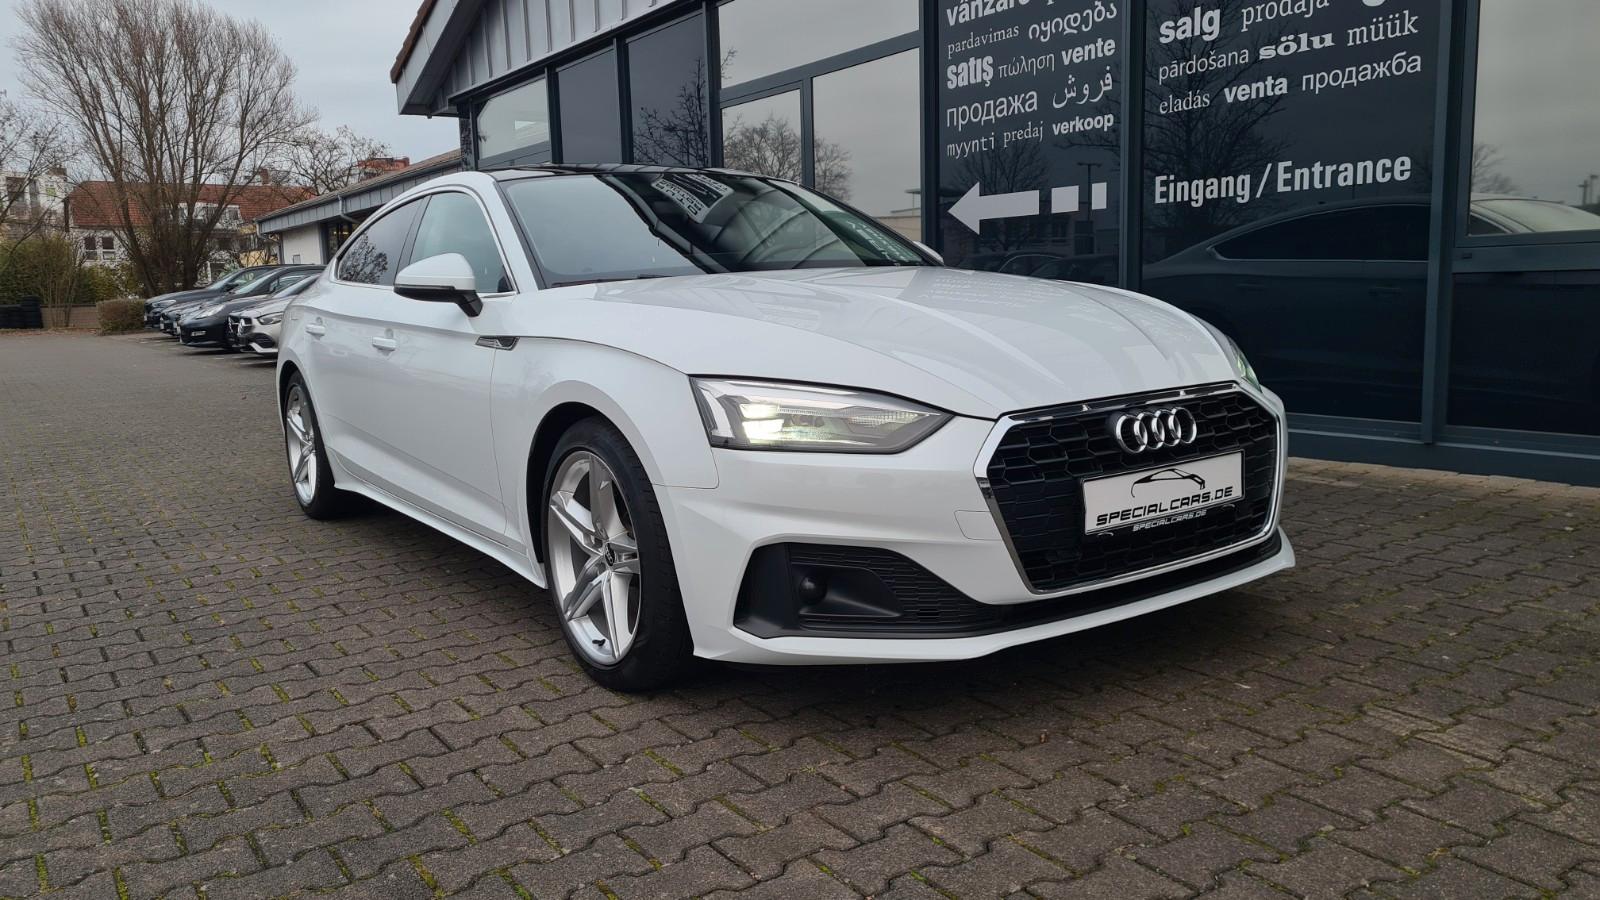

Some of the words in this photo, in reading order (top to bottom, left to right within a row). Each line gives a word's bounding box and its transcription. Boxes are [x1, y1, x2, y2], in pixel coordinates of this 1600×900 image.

[946, 0, 1030, 26] vânza
[1159, 7, 1221, 44] salg
[948, 25, 1019, 59] pardavimas
[1061, 37, 1116, 66] vente
[1159, 49, 1249, 85] pārdošana
[1259, 32, 1335, 60] sölu
[1346, 10, 1419, 47] müük
[947, 55, 994, 89] satış
[998, 53, 1055, 79] πώληση
[1302, 51, 1422, 94] продажба
[1052, 65, 1113, 109] فروش
[1159, 90, 1211, 115] eladás
[1223, 75, 1289, 104] venta
[946, 90, 1038, 132] продажа
[946, 131, 995, 160] myynti
[1003, 120, 1043, 148] predaj
[1052, 113, 1114, 136] verkoop
[1154, 174, 1251, 208] Eingang
[1276, 155, 1412, 193] Entrance
[1096, 486, 1233, 527] SPECIALCARS.DE
[1132, 509, 1207, 532] SPECIALCARS.DE
